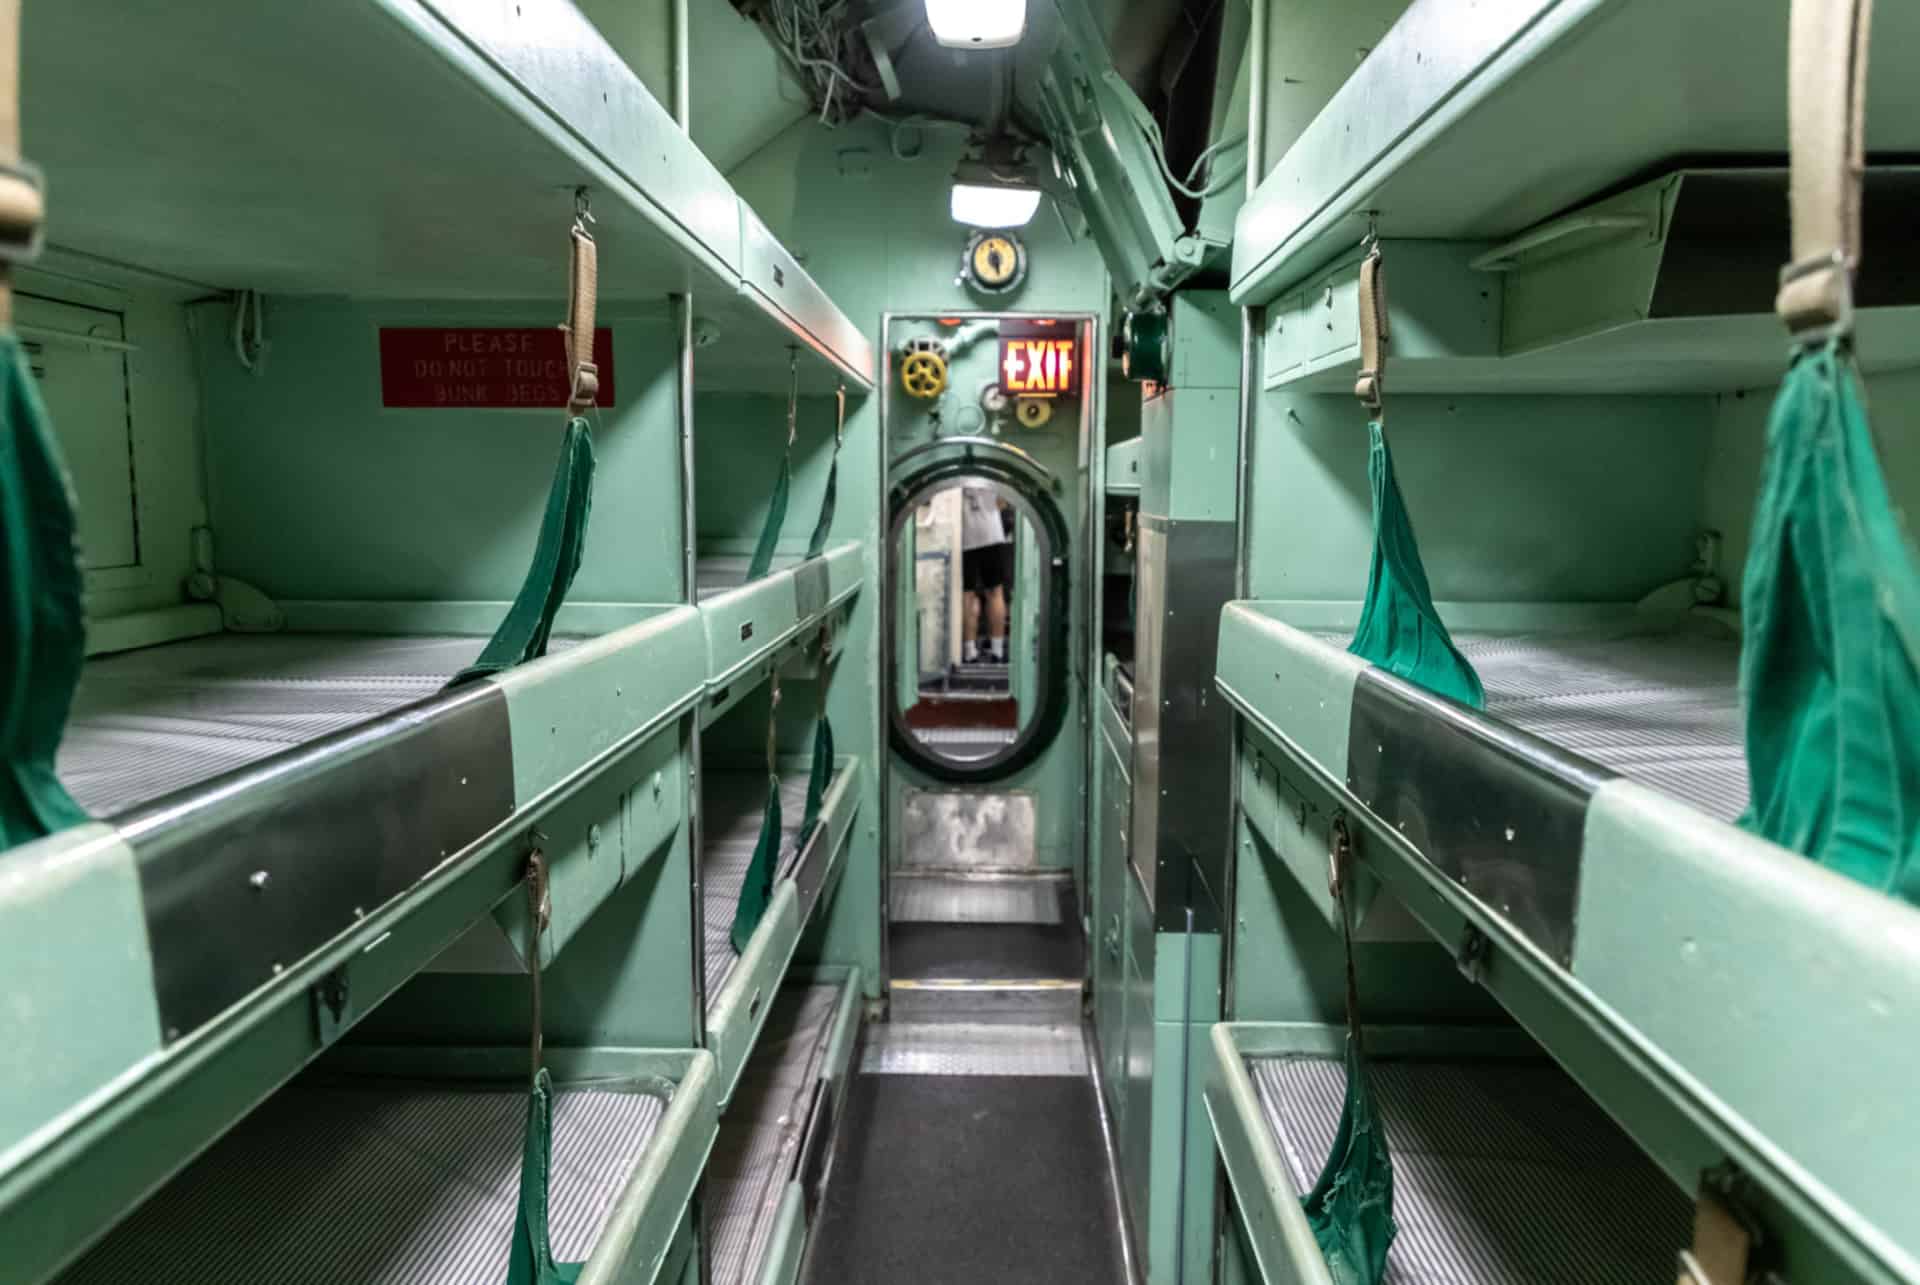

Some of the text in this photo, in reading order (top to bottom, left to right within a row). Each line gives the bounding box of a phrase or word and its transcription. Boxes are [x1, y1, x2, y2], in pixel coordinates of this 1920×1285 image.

[444, 333, 536, 353] PLEASE
[414, 359, 441, 378] DO
[448, 358, 488, 378] NOT
[1003, 341, 1073, 390] EXIT
[435, 383, 488, 402] BUNK
